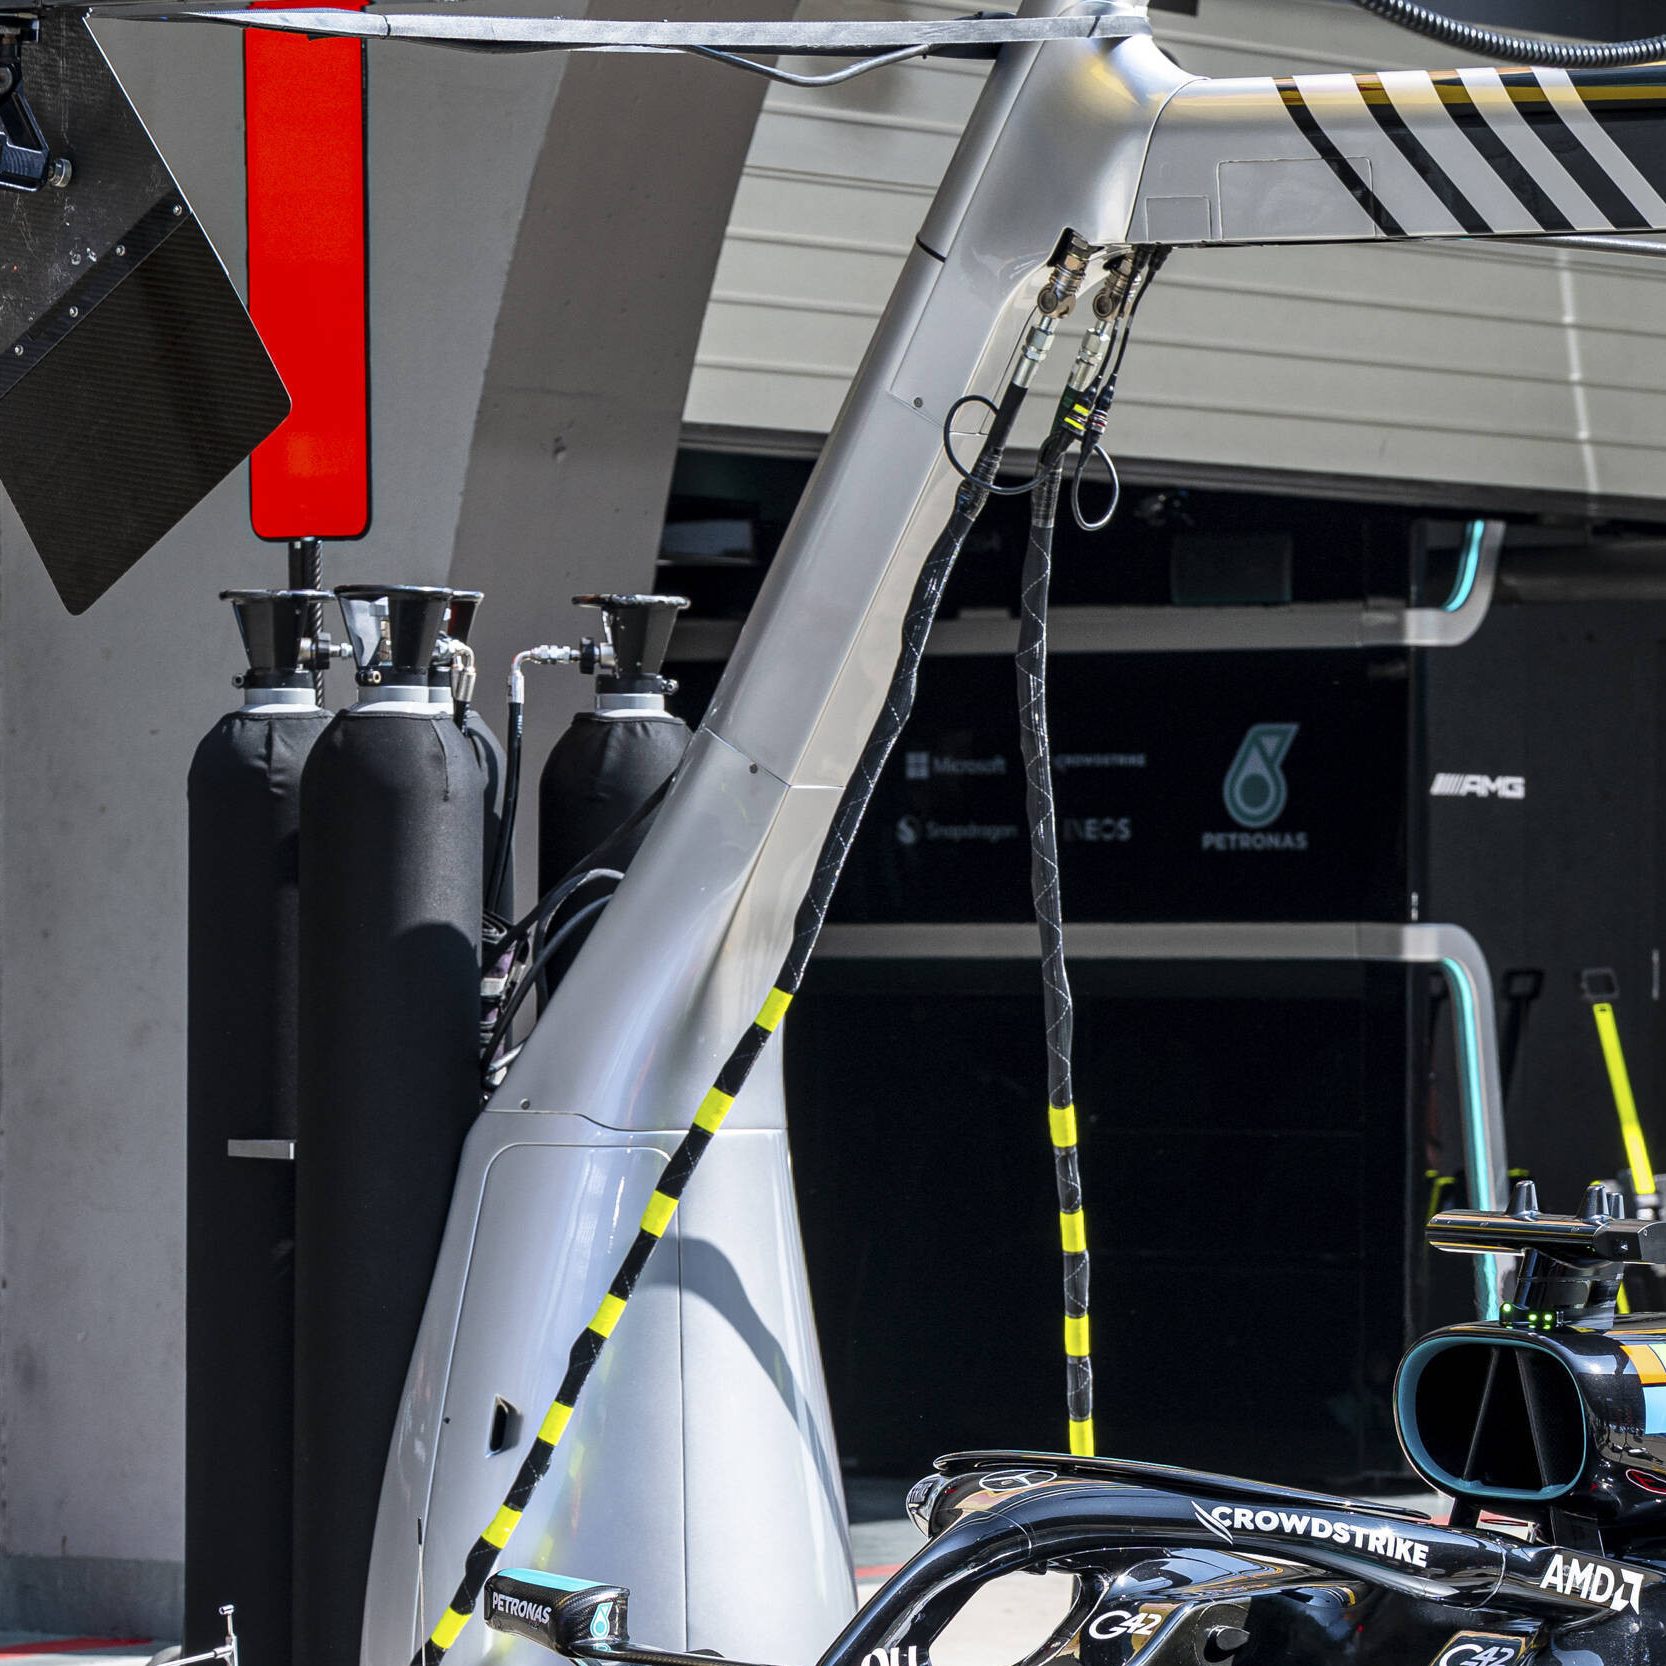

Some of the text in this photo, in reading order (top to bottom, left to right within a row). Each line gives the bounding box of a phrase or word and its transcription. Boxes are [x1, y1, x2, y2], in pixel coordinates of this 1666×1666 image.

[933, 754, 1007, 776] Microsoft
[927, 822, 1019, 843] Snapdragon
[1203, 832, 1309, 851] PETRONAS
[1211, 1505, 1430, 1568] CROWDSTRIKE
[1539, 1553, 1617, 1602] AMD
[492, 1592, 552, 1626] PETRONAS
[1089, 1610, 1162, 1640] G42
